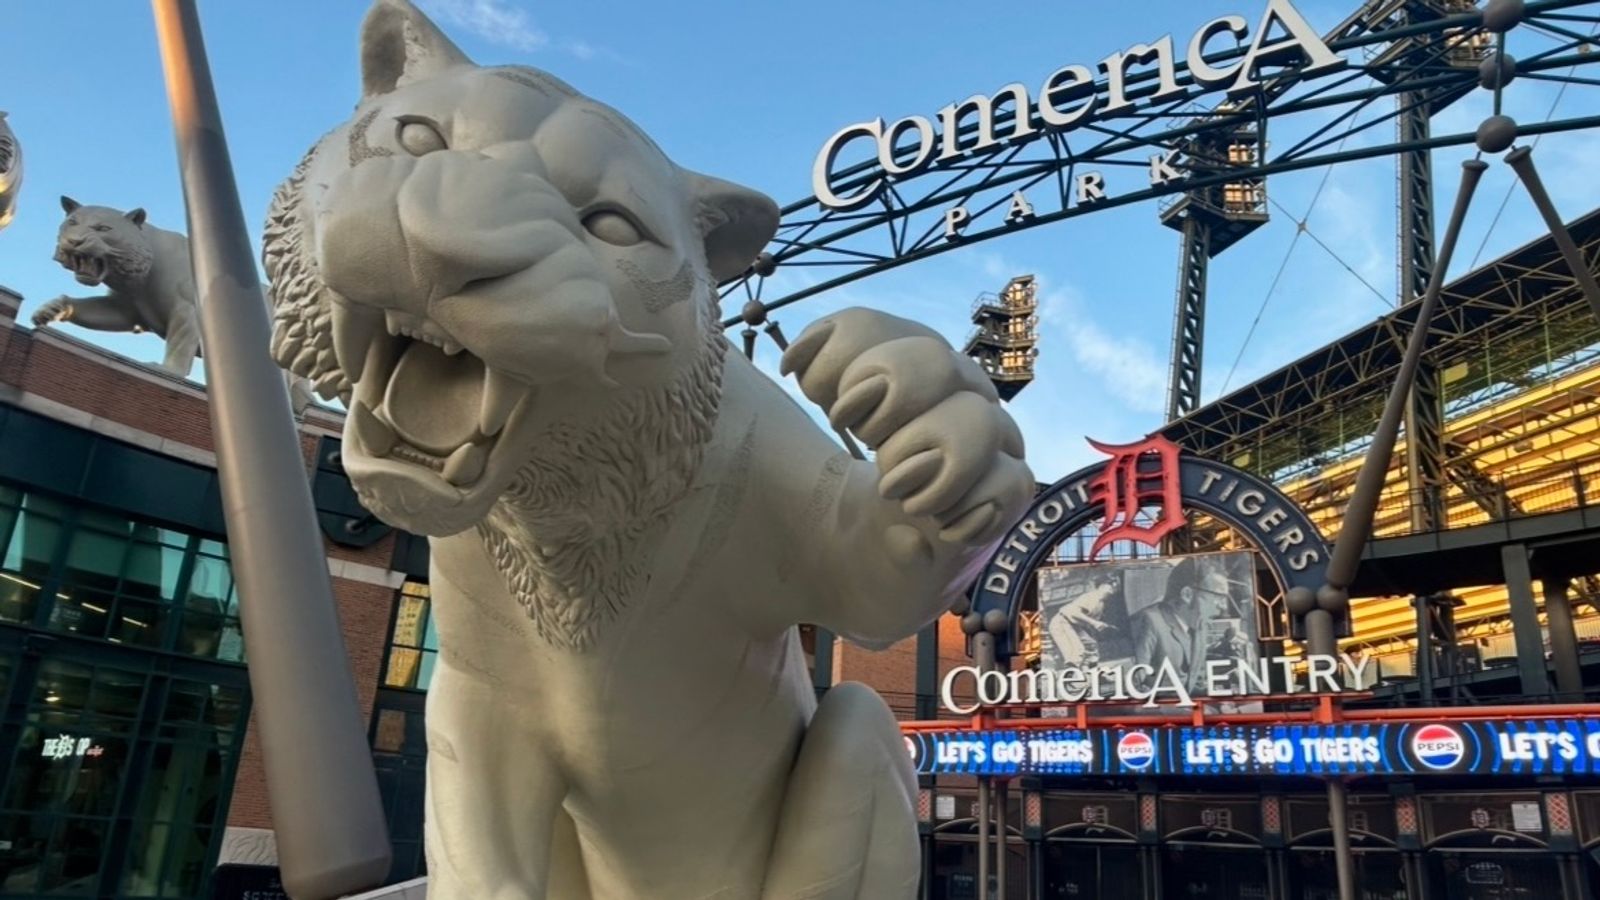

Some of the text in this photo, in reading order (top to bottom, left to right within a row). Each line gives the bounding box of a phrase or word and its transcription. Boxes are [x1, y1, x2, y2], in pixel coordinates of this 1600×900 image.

[945, 149, 1192, 241] PARK
[984, 479, 1093, 596] DETROIT
[1197, 469, 1319, 572] TIGERS
[1206, 654, 1372, 698] ENTRY
[938, 740, 1093, 763] LET'S GO TIGERS
[1185, 737, 1381, 764] LET'S GO TIGERS
[1416, 743, 1461, 752] PEPSI
[1500, 732, 1578, 760] LET'S
